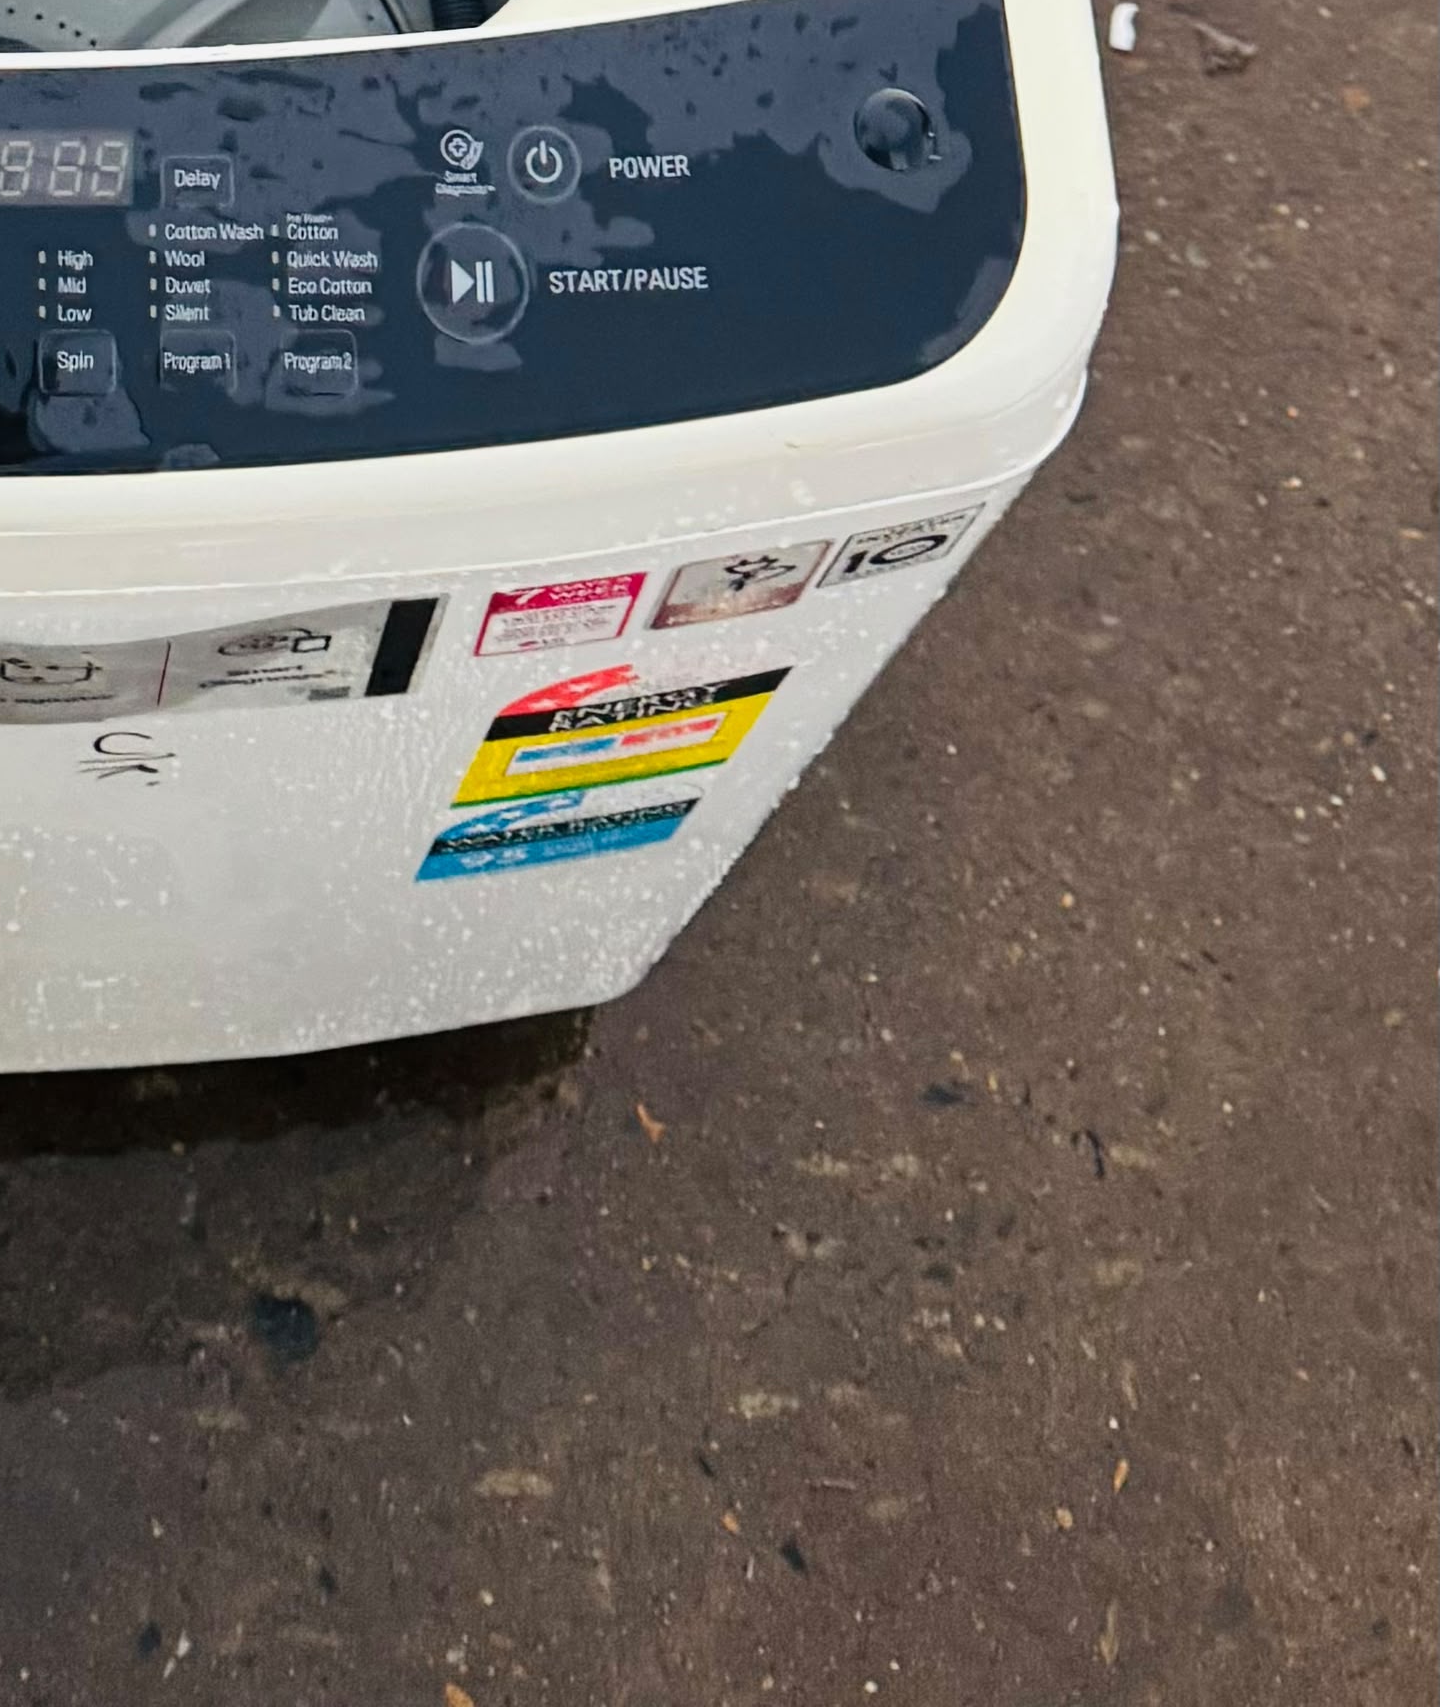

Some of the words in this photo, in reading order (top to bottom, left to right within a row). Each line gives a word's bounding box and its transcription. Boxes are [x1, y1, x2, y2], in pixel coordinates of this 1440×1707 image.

[609, 154, 691, 179] POWER
[173, 169, 221, 190] Delay
[165, 224, 217, 241] Cotton
[220, 223, 265, 240] Wash
[287, 223, 339, 241] Cotton
[58, 250, 94, 271] High
[165, 250, 206, 268] Wool
[287, 251, 331, 269] Quick
[333, 251, 379, 268] Wash
[58, 277, 87, 294] Mid
[165, 277, 211, 294] Duvet
[288, 277, 318, 295] Eco
[320, 277, 373, 295] Cotton
[548, 266, 709, 294] START/PAUSE
[58, 305, 92, 322] Low
[165, 304, 210, 323] Silent
[288, 304, 318, 322] Tub
[321, 304, 366, 322] Clean
[56, 350, 94, 373] Spin
